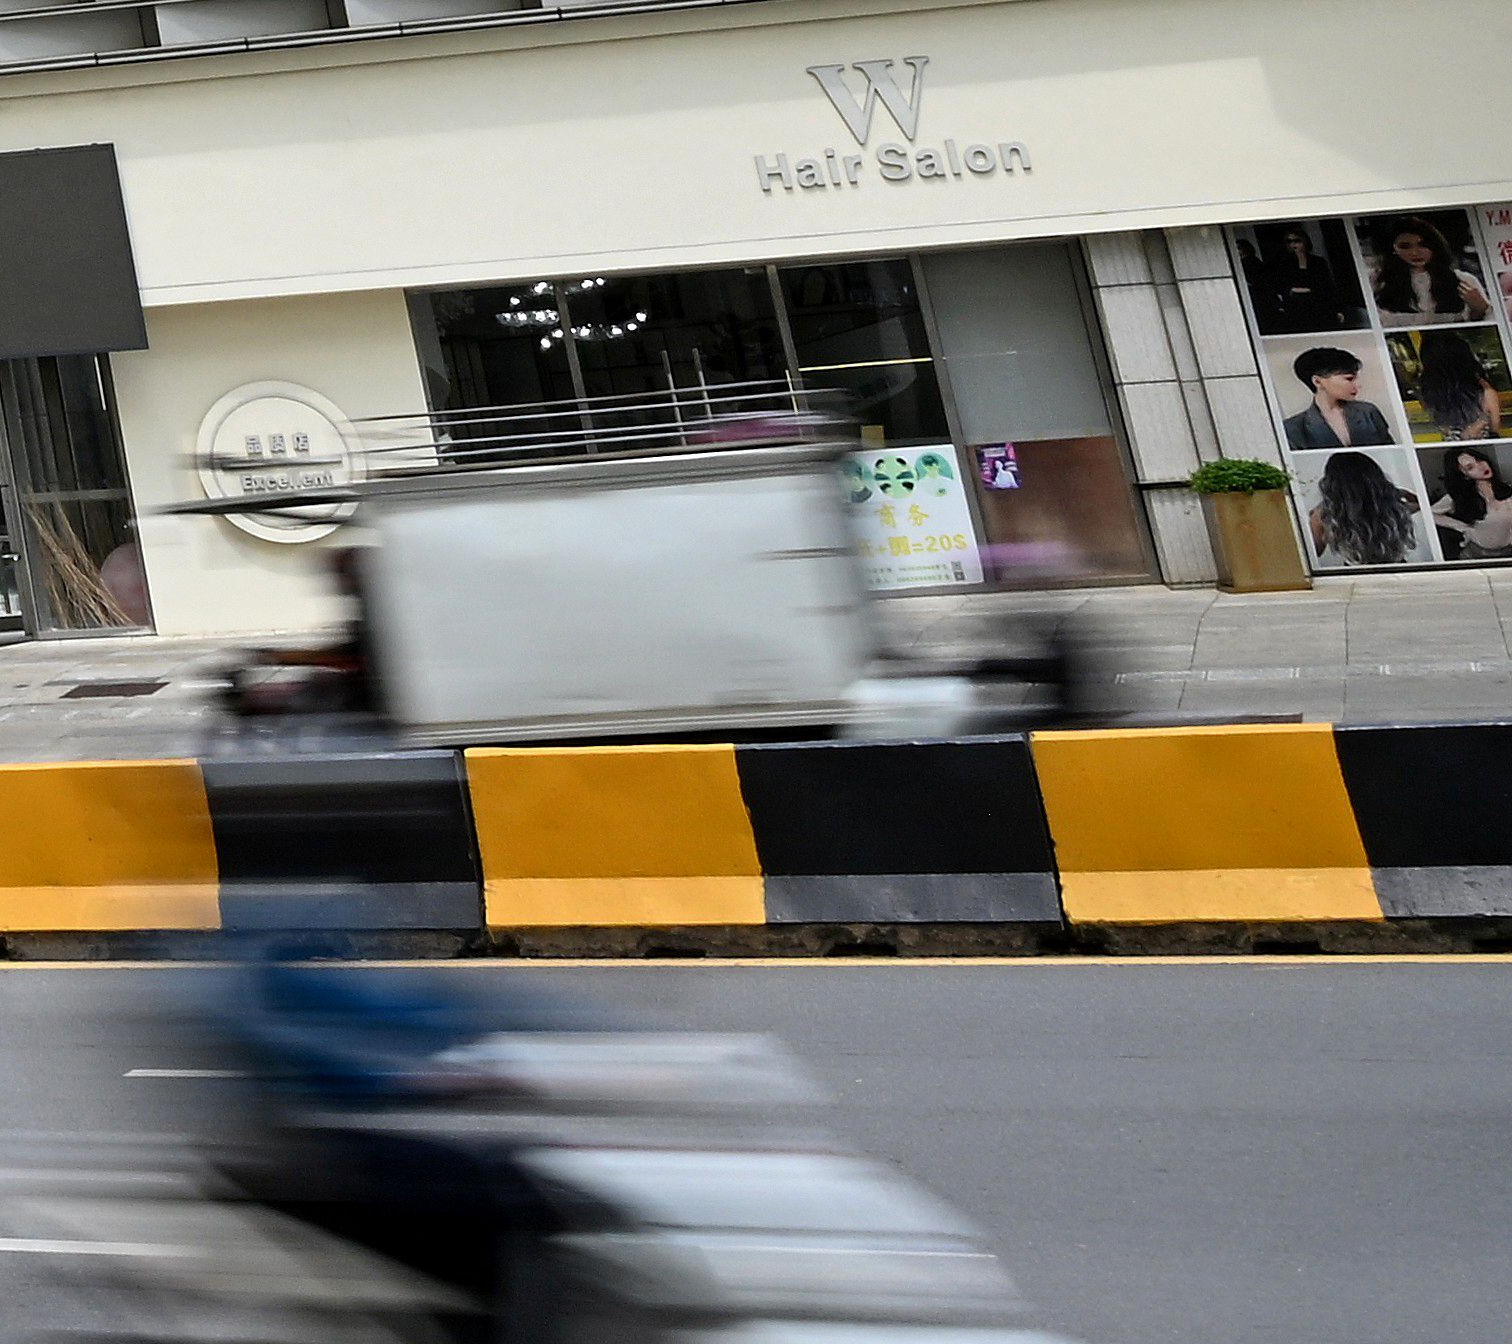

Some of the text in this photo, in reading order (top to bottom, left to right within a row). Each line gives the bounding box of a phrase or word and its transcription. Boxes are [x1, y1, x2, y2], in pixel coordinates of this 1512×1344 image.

[806, 55, 930, 146] W
[754, 138, 1032, 193] Hair Salon
